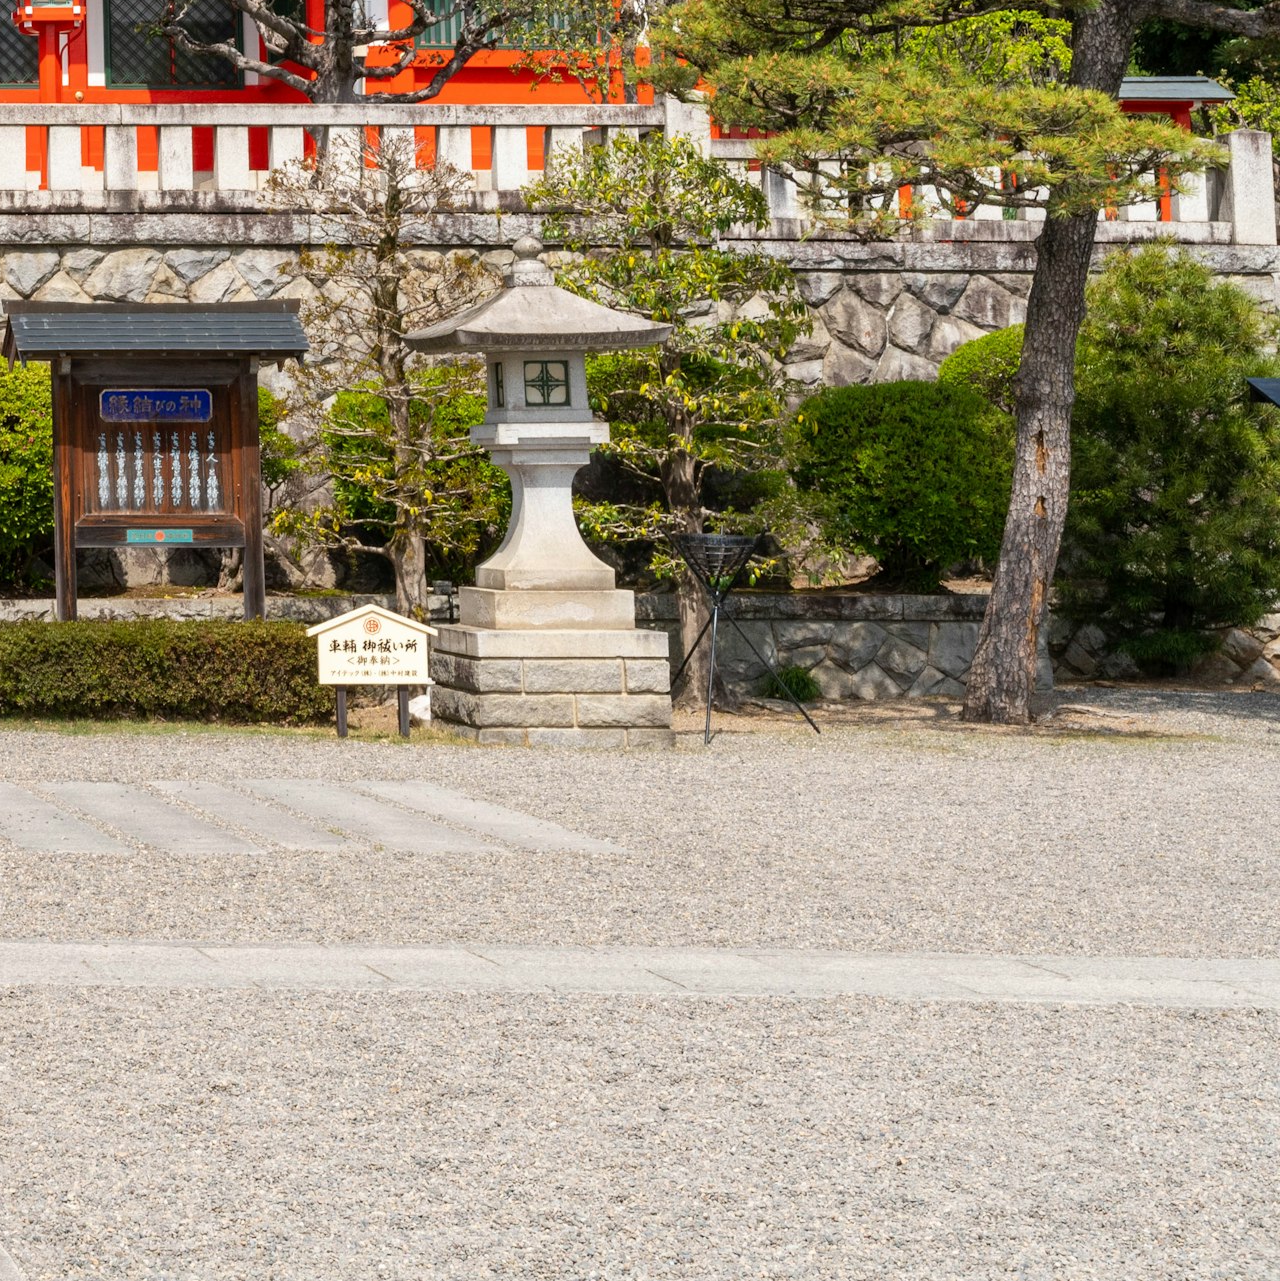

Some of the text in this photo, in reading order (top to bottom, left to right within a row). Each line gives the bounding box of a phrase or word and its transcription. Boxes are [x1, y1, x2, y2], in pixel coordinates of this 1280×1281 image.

[108, 394, 202, 414] 縁結びの神
[362, 638, 418, 653] 御祓い所
